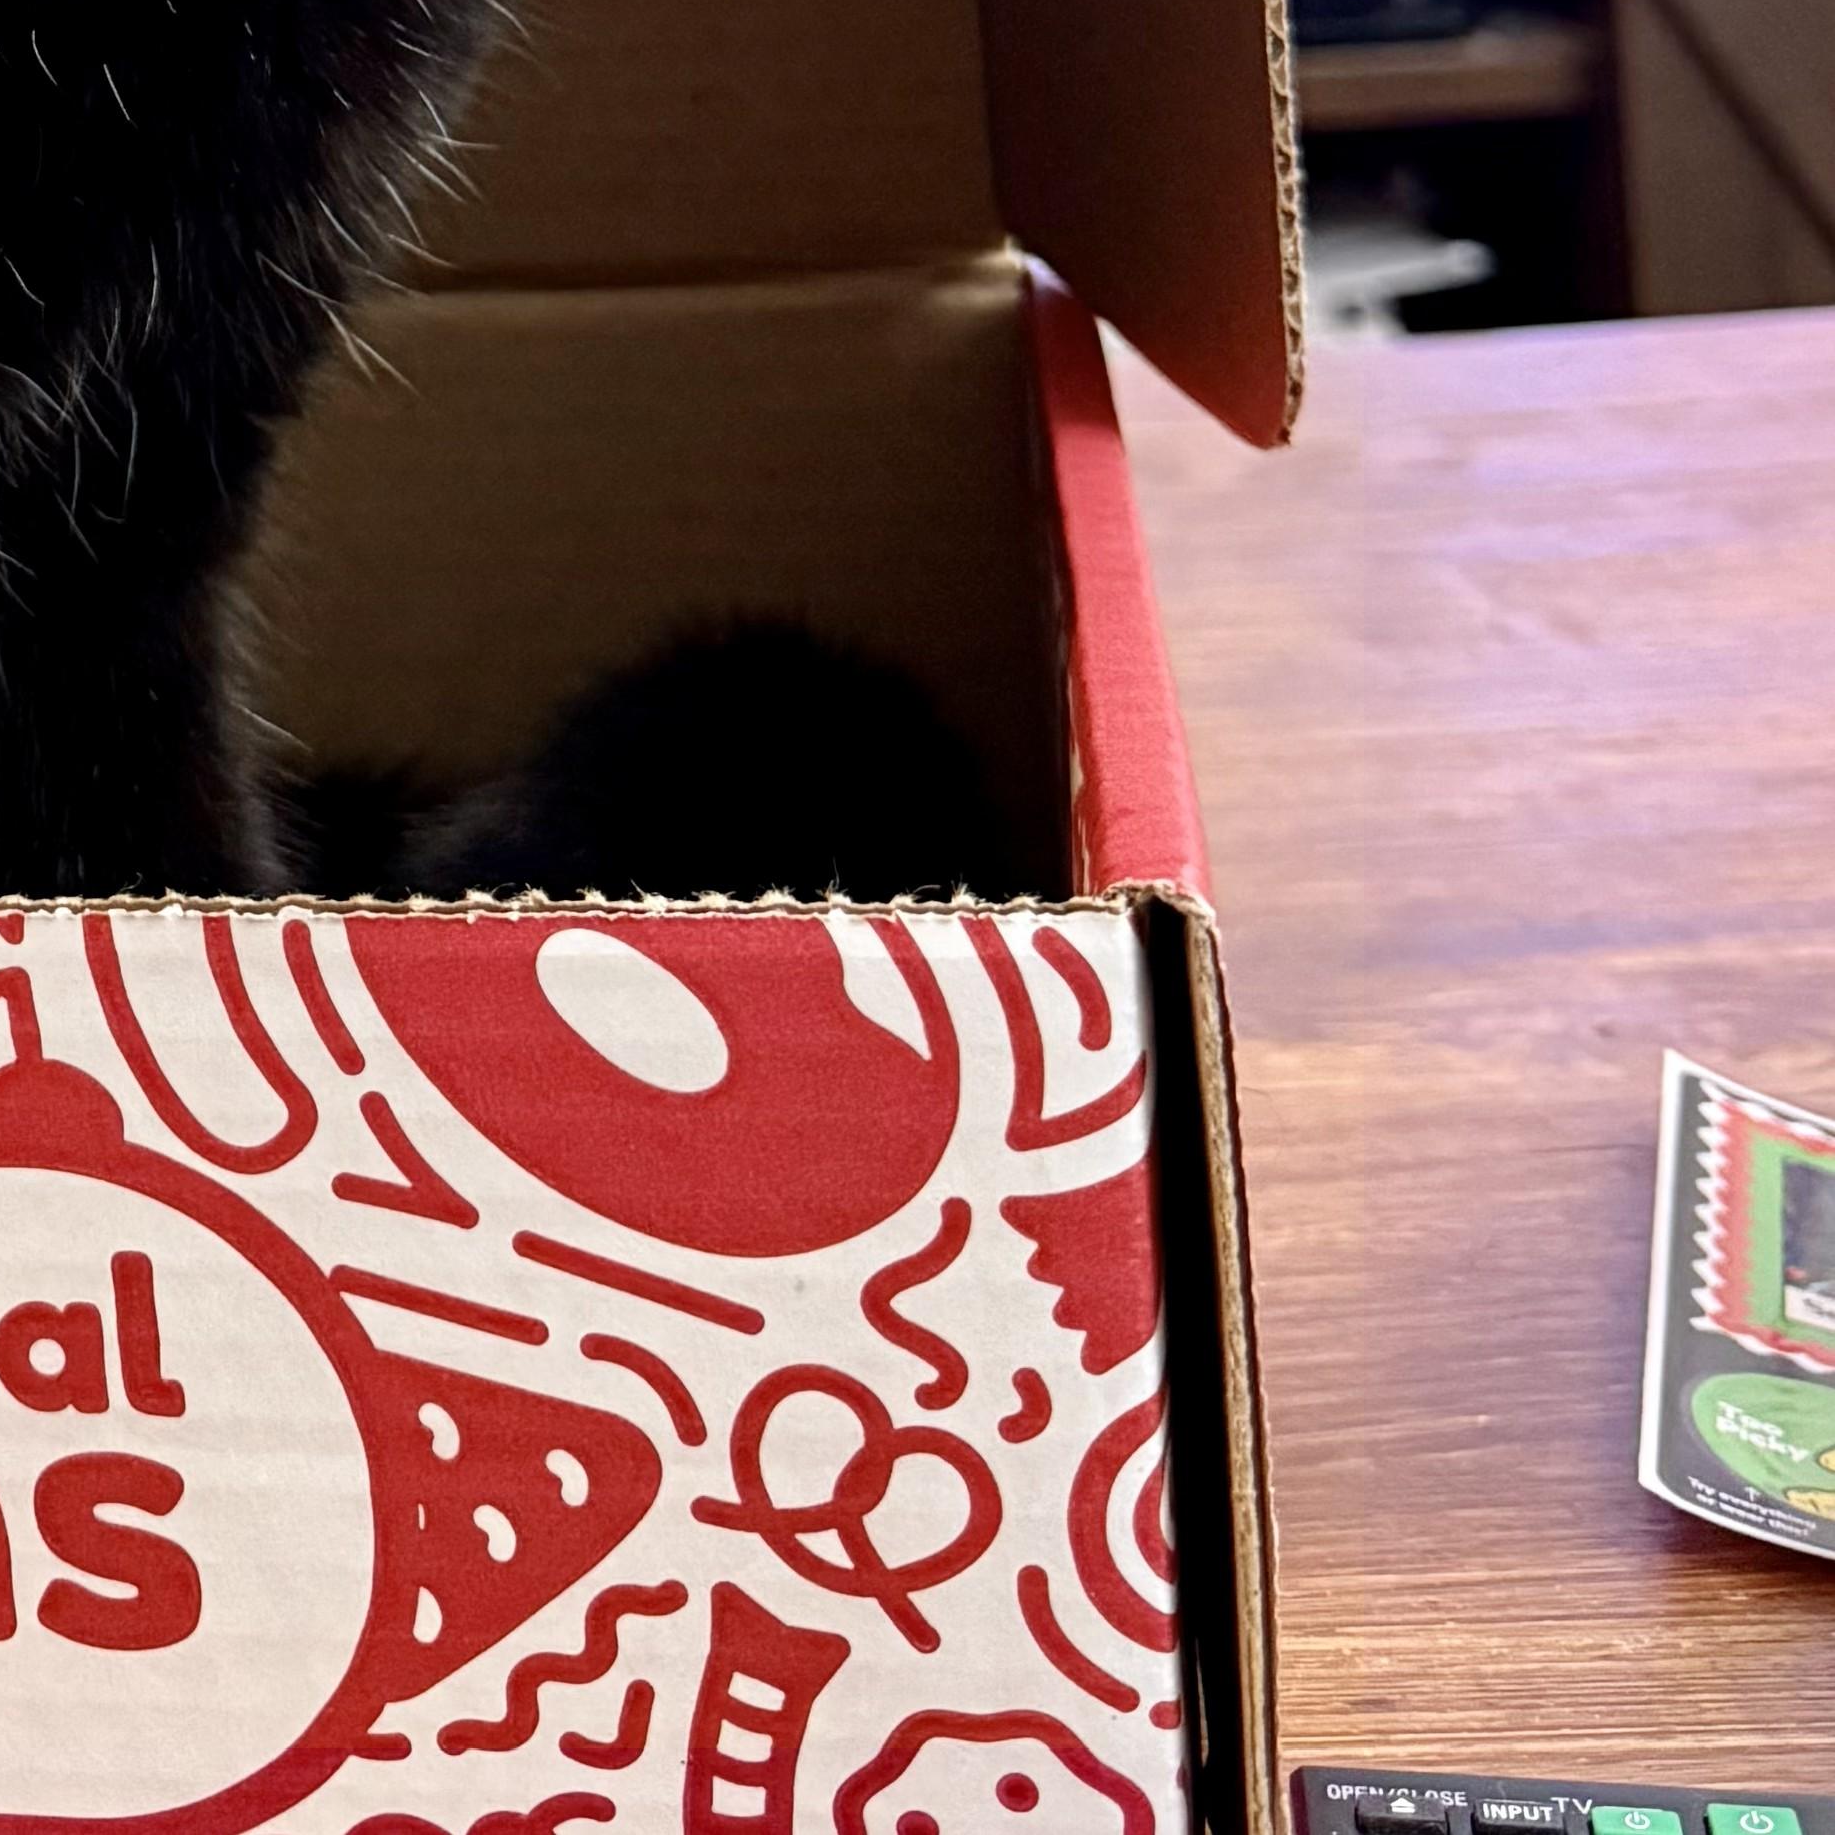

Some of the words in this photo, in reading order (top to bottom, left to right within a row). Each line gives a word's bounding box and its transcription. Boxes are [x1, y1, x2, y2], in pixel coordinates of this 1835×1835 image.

[1718, 1400, 1784, 1437] Too
[1716, 1416, 1810, 1462] Picky
[1482, 1803, 1553, 1821] INPUT
[1550, 1796, 1593, 1815] TV
